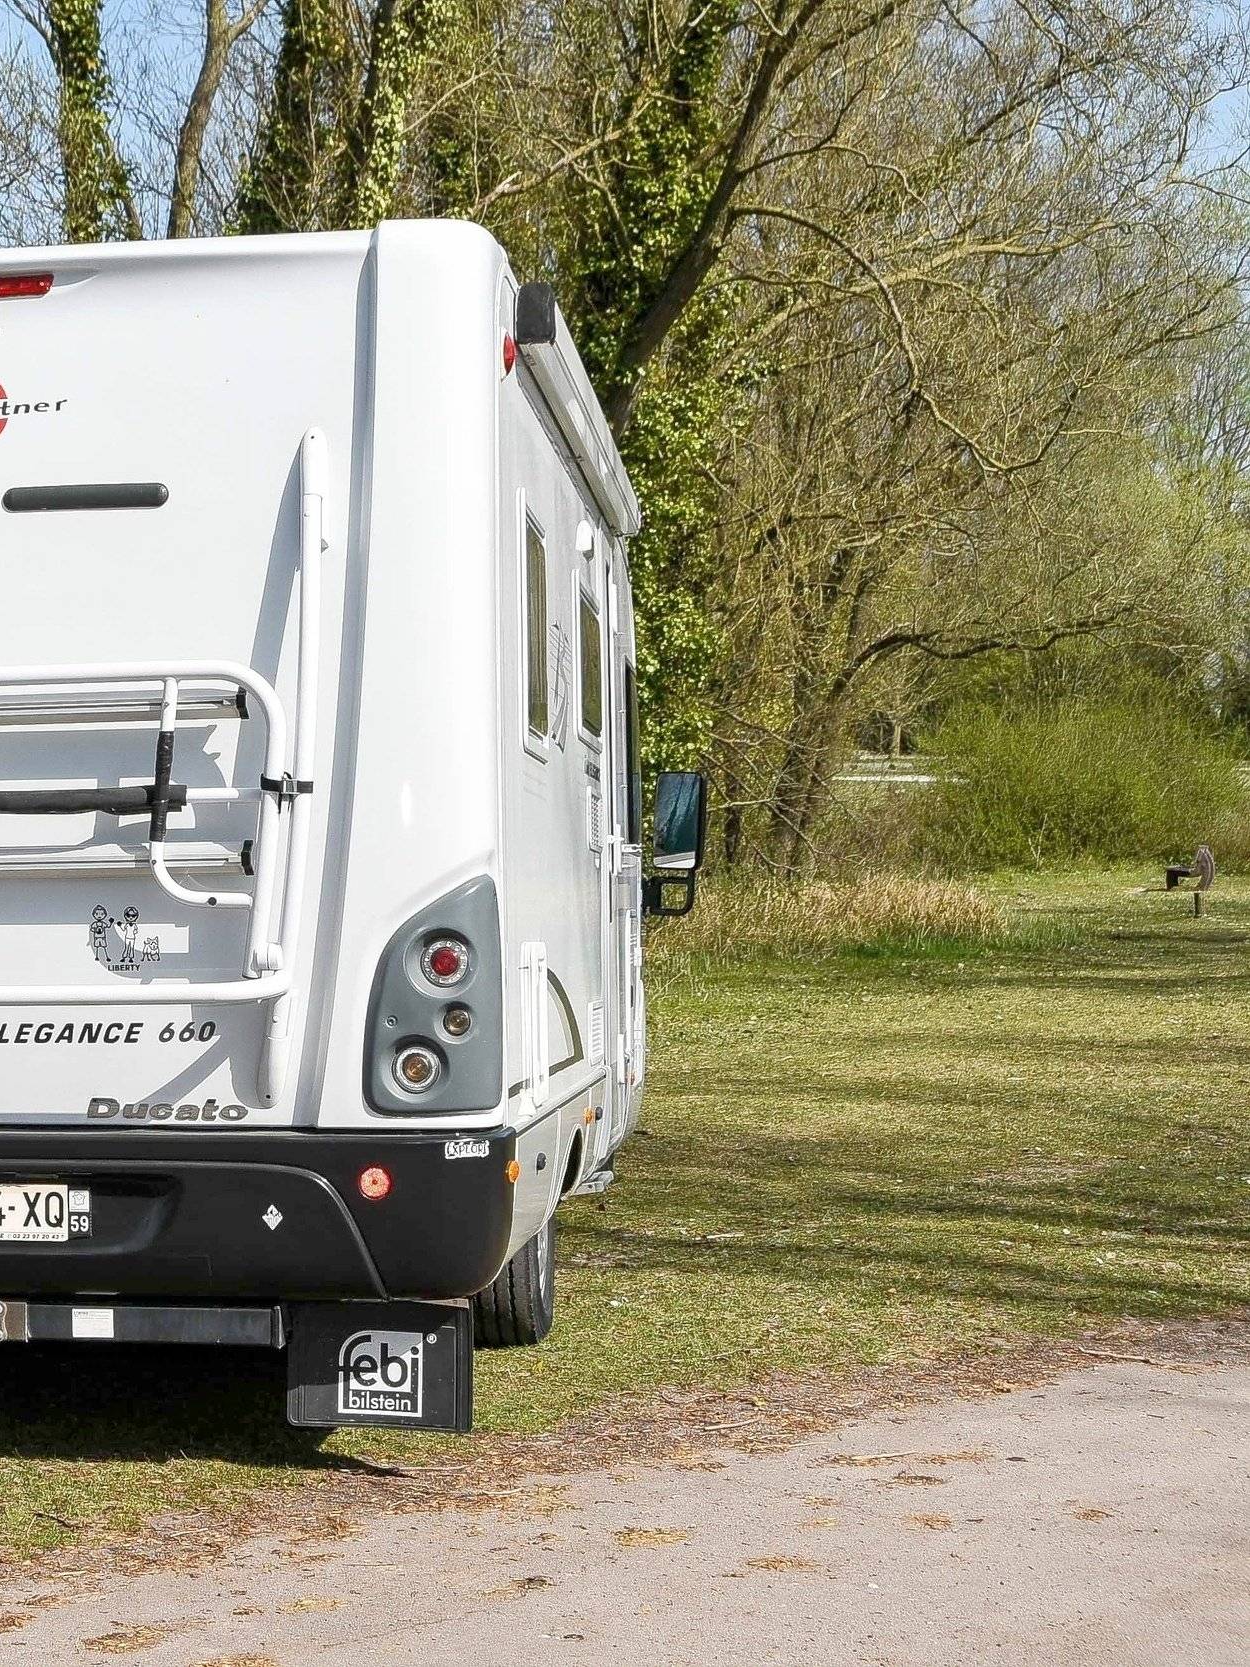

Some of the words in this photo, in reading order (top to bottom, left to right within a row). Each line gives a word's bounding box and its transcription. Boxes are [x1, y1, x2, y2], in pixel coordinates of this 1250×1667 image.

[107, 964, 141, 972] LIBERTY
[158, 1020, 217, 1043] 660
[86, 1097, 249, 1122] Ducato
[70, 1215, 89, 1233] 59
[338, 1334, 420, 1393] febi
[348, 1390, 411, 1412] bilstein
